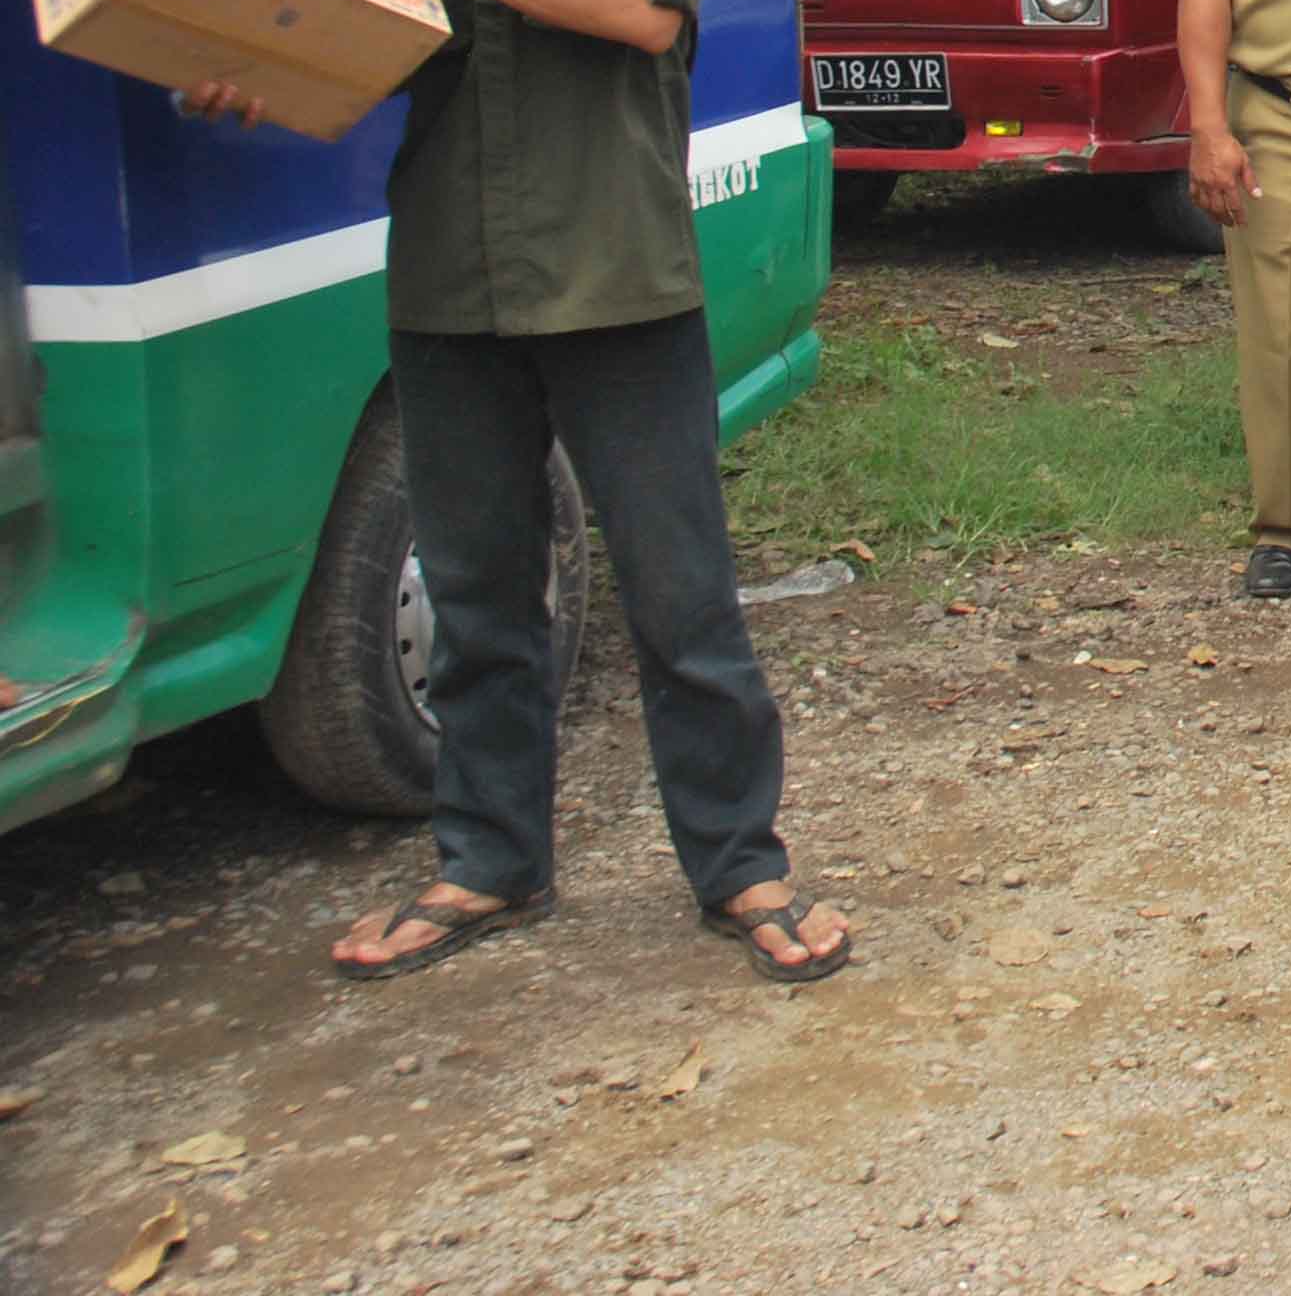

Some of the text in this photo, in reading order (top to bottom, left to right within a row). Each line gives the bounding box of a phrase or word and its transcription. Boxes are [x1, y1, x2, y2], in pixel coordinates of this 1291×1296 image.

[815, 59, 942, 89] D 1849 YR
